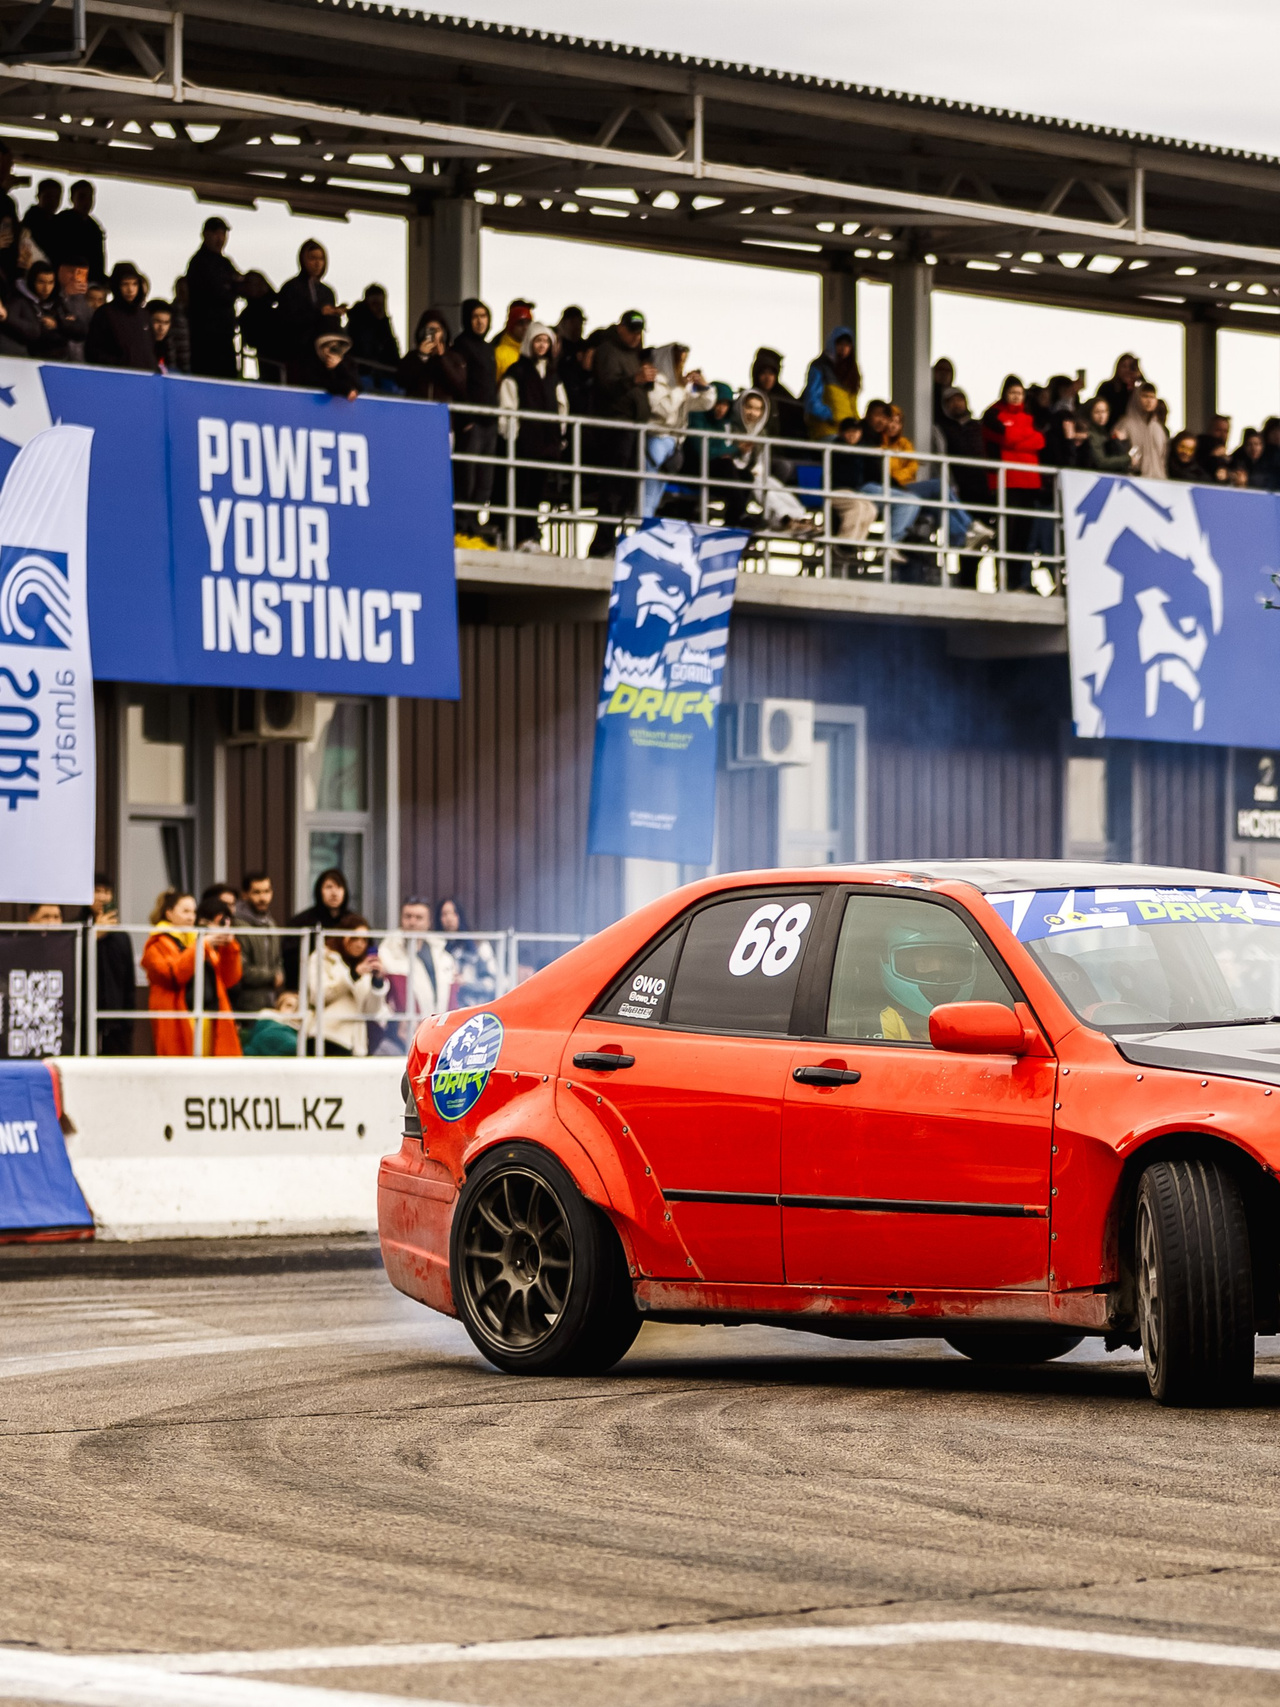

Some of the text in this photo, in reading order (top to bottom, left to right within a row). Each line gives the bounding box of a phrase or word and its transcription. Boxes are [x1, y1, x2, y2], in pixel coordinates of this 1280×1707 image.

[198, 417, 370, 507] POWER
[199, 497, 330, 581] YOUR
[201, 576, 422, 665] INSTINCT
[728, 902, 812, 977] 68
[184, 1097, 345, 1131] SOKOL.KZ
